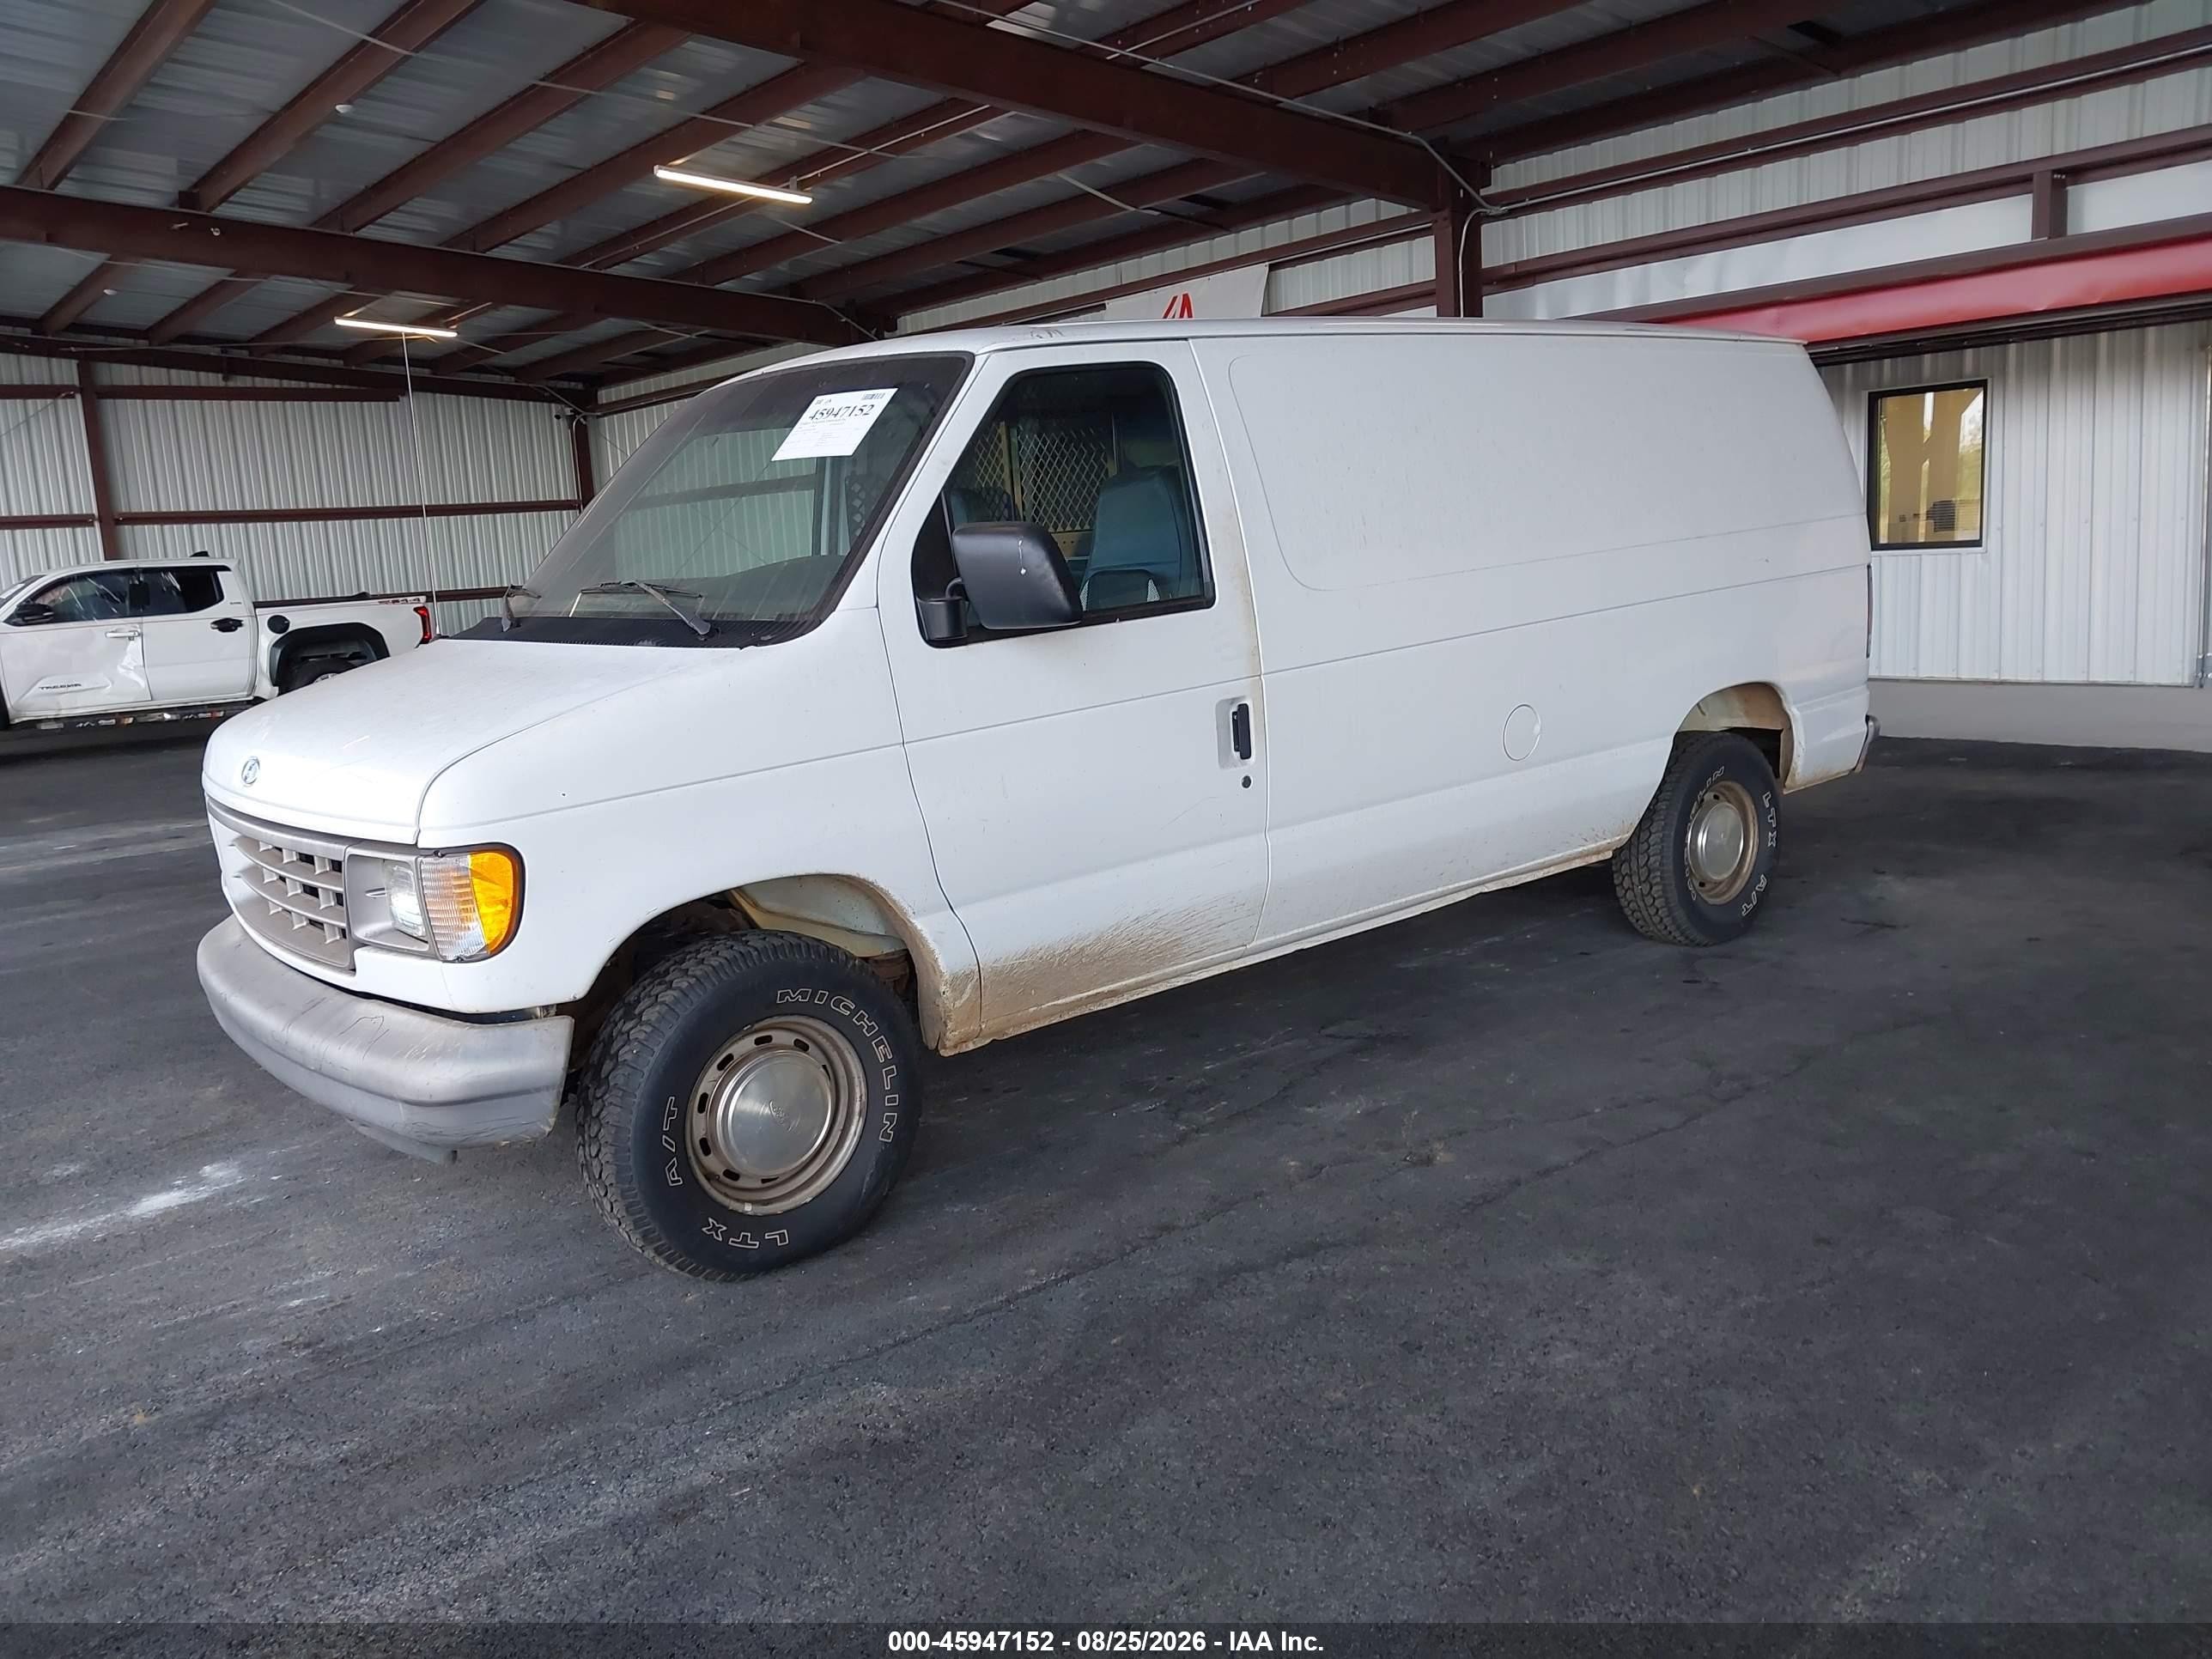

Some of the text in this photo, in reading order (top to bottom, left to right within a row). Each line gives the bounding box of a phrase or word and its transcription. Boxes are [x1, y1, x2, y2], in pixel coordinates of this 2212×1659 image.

[809, 404, 875, 421] 45947152
[1741, 791, 1778, 916] LTX A/T
[776, 988, 900, 1143] MICHELIN
[662, 1096, 789, 1249] LTX A/T
